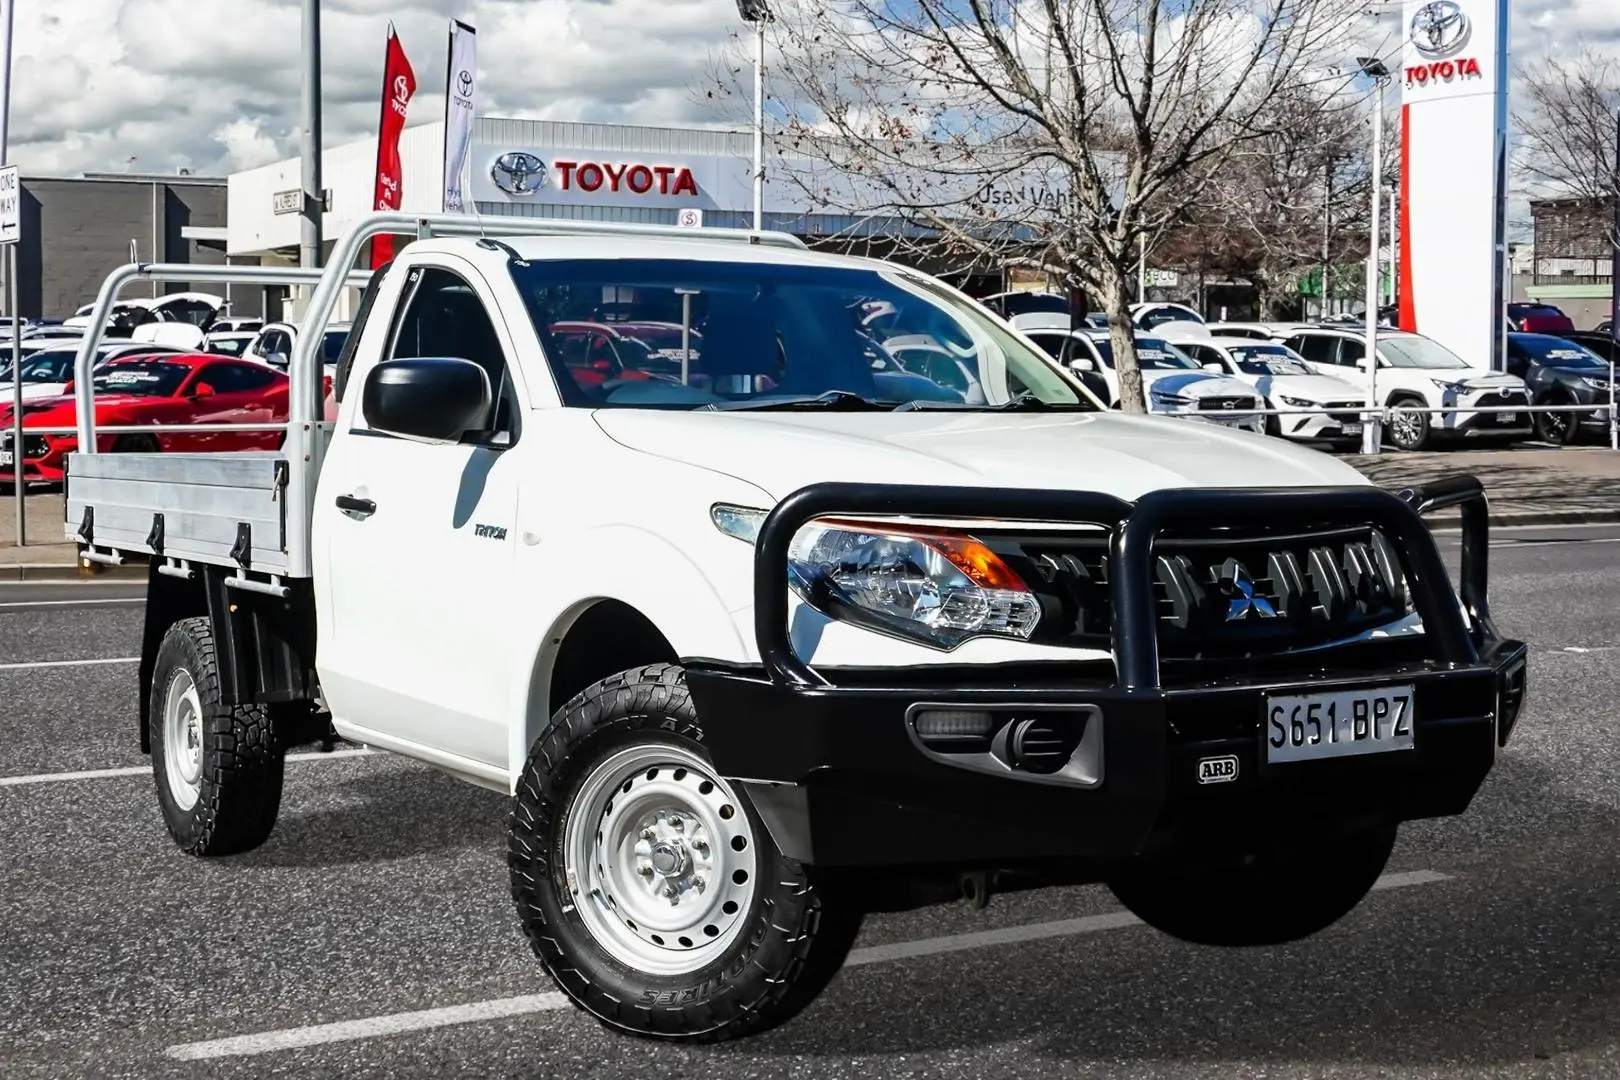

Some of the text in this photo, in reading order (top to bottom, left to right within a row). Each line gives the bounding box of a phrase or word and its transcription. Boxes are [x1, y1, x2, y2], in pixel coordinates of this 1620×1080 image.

[1404, 58, 1481, 83] TOYOTA
[555, 161, 698, 196] TOYOTA
[979, 184, 1025, 204] Used
[1270, 696, 1409, 749] S651 BPZ
[1201, 761, 1235, 778] ARB
